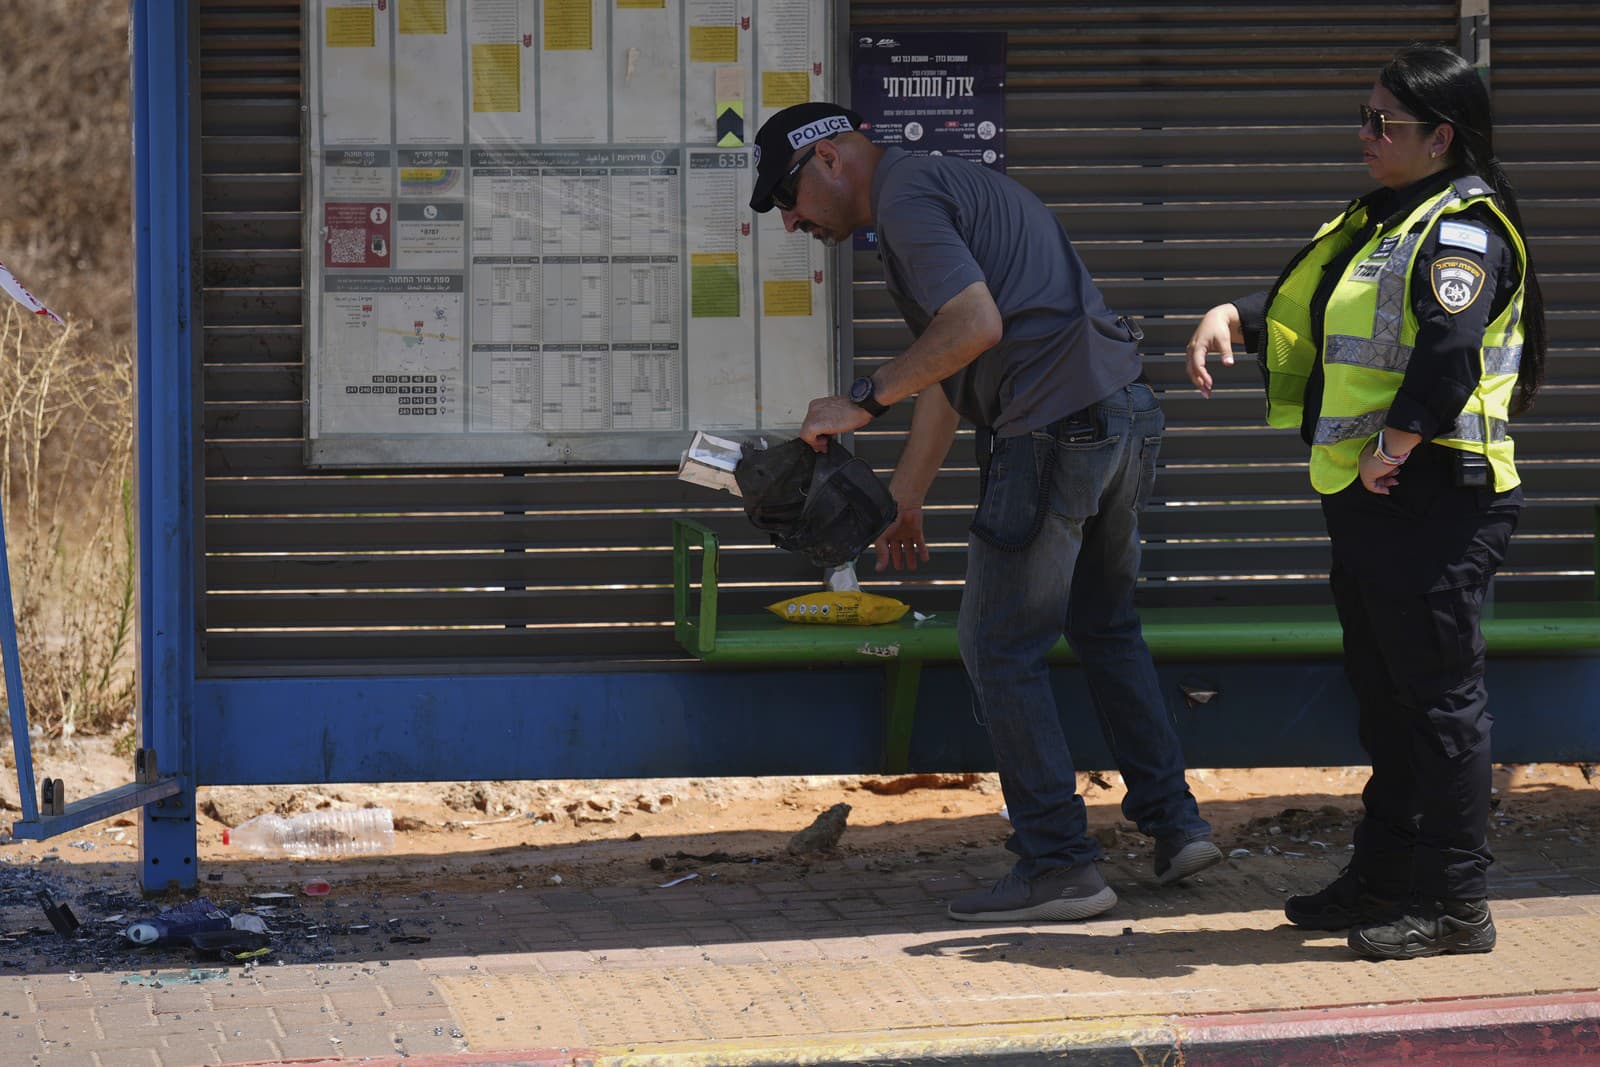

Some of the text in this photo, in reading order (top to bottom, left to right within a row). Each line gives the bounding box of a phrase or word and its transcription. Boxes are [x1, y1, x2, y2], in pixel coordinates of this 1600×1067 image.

[883, 76, 974, 99] צדק תחבורתי
[792, 118, 849, 146] POLICE
[718, 153, 745, 168] 635
[389, 276, 450, 284] מפת אזור התחנה
